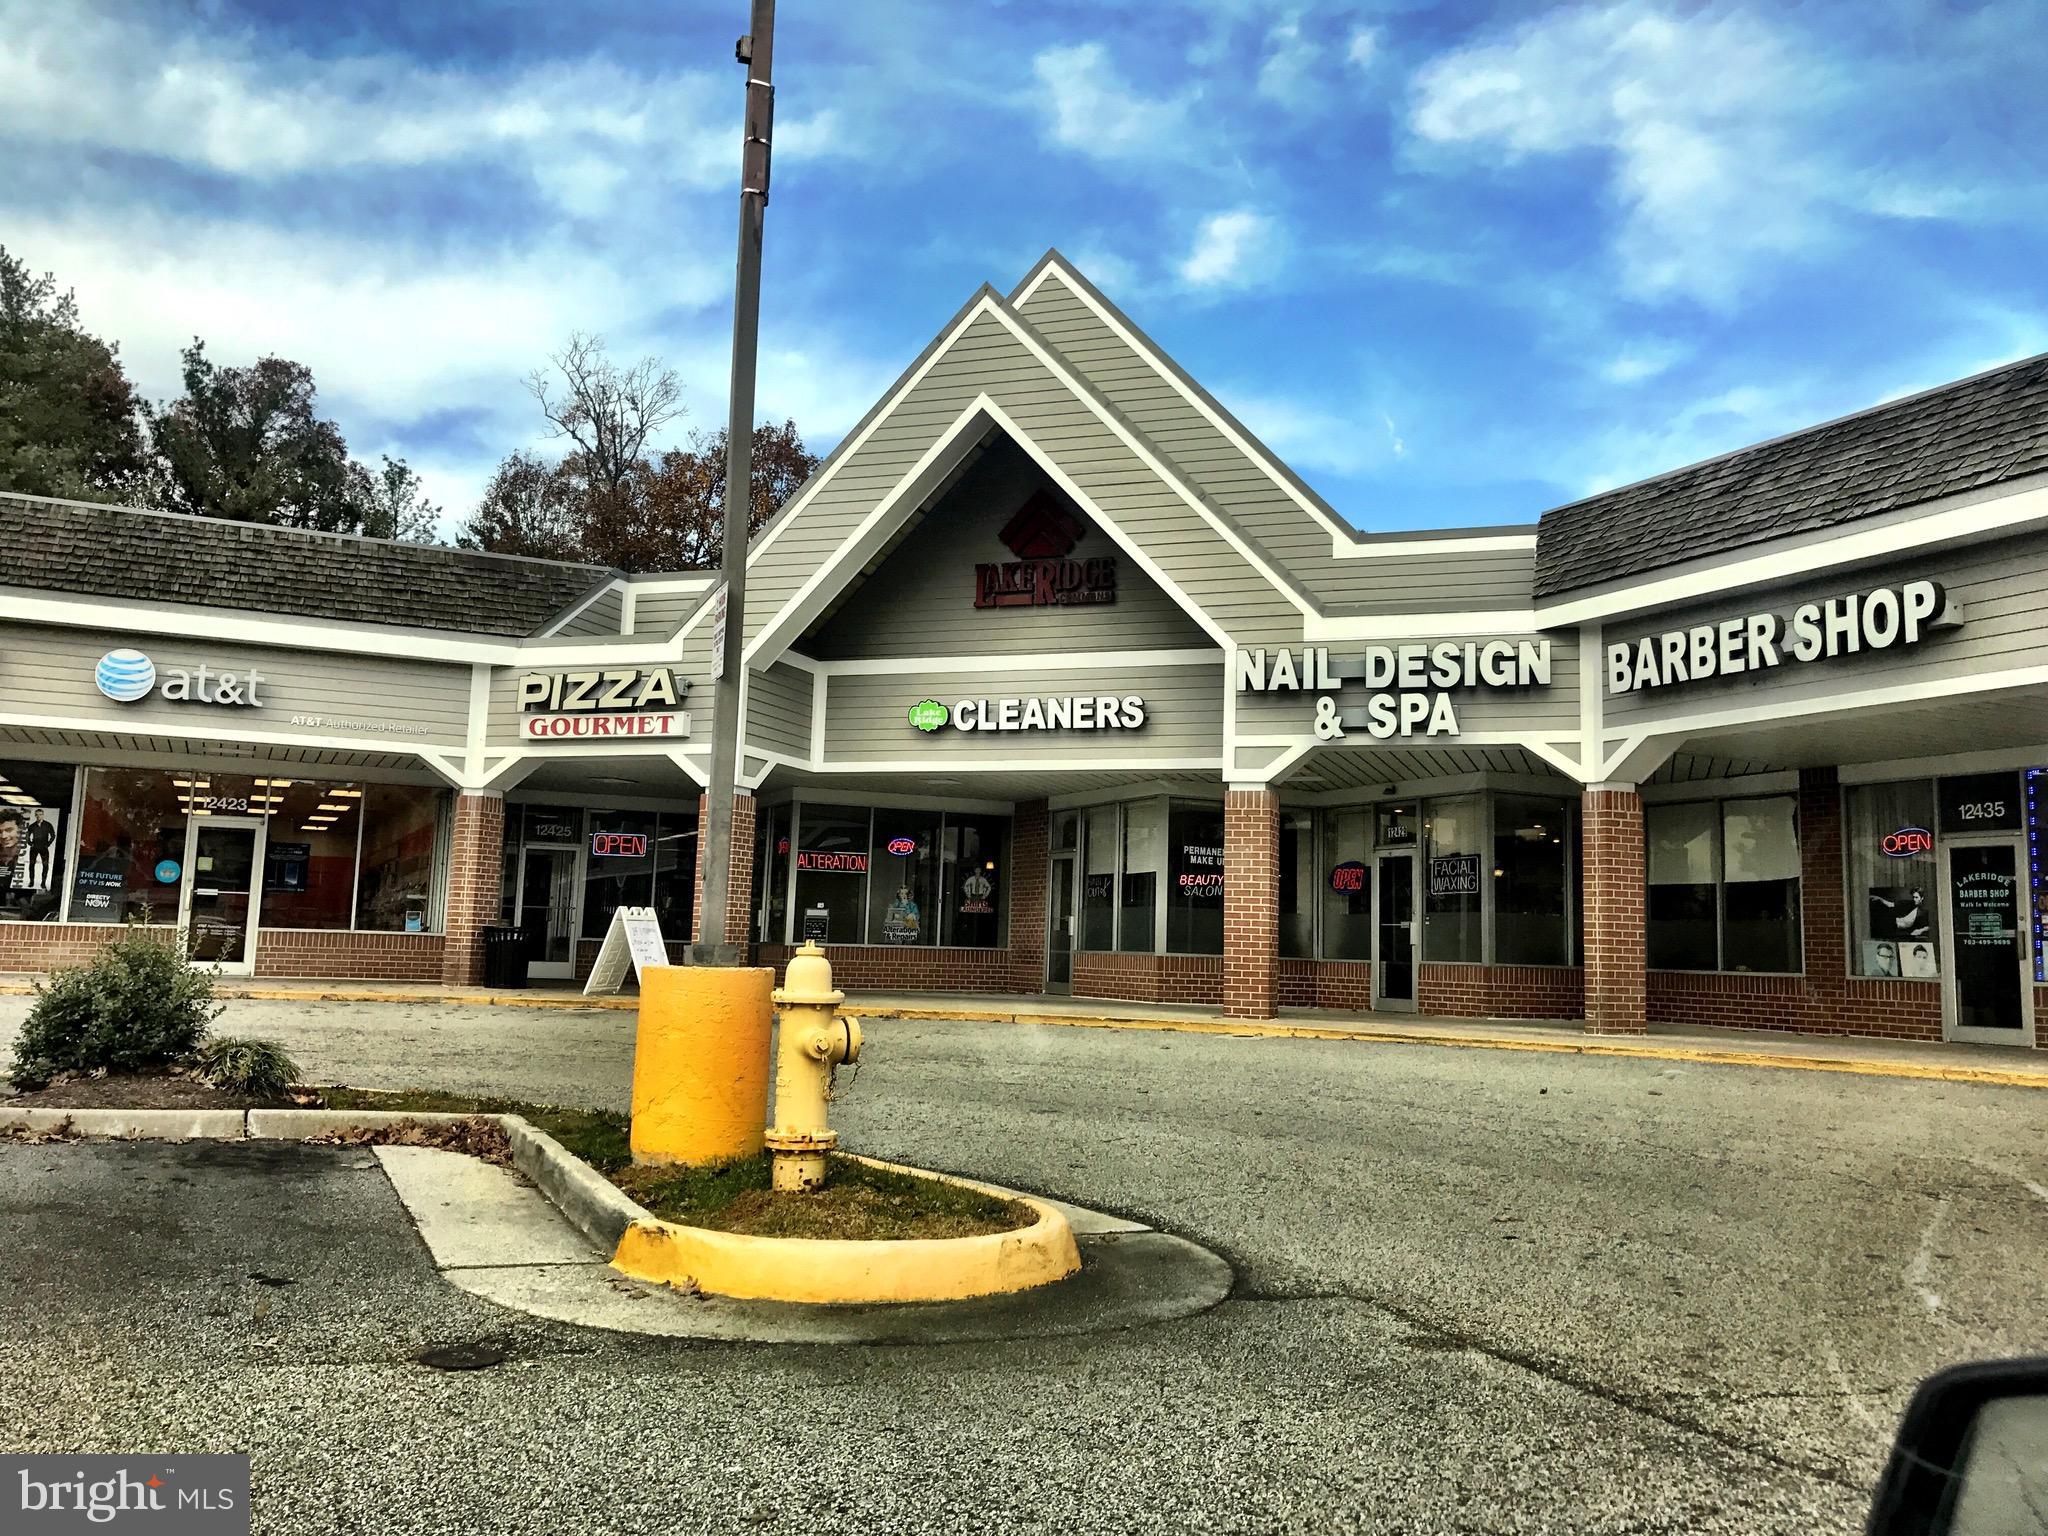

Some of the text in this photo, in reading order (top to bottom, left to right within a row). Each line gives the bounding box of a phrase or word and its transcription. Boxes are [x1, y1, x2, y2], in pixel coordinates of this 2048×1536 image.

[1607, 579, 1938, 694] BARBER SHOP
[1236, 639, 1552, 691] NAIL DESIGN
[161, 664, 265, 708] at&t
[517, 668, 678, 712] PIZZA
[916, 708, 942, 716] Lake
[953, 696, 1145, 731] CLEANERS
[1313, 692, 1460, 741] & SPA
[290, 714, 429, 736] AT&T Authorized Retailer
[529, 715, 675, 736] GOURMET
[203, 796, 248, 811] 12423
[1958, 801, 2006, 820] 12435
[535, 824, 573, 837] 12425
[594, 835, 646, 854] OPEN
[888, 841, 915, 853] OPEN
[1883, 833, 1931, 852] OPEN
[1183, 845, 1224, 857] PERMANE
[797, 854, 867, 871] ALTERATION
[1190, 855, 1225, 866] MAKE U
[1434, 860, 1475, 876] FACIAL
[80, 871, 123, 880] THE FUTURE
[1179, 874, 1224, 886] BEAUTY
[1333, 868, 1364, 890] OPEN
[1433, 876, 1476, 891] WAXING
[1956, 872, 2011, 888] LAKERIDGE
[1184, 885, 1223, 898] SALON
[1959, 889, 2010, 898] BARBER SHOP
[84, 899, 110, 908] NOW
[882, 926, 919, 934] Alterations
[892, 933, 917, 941] Repairs
